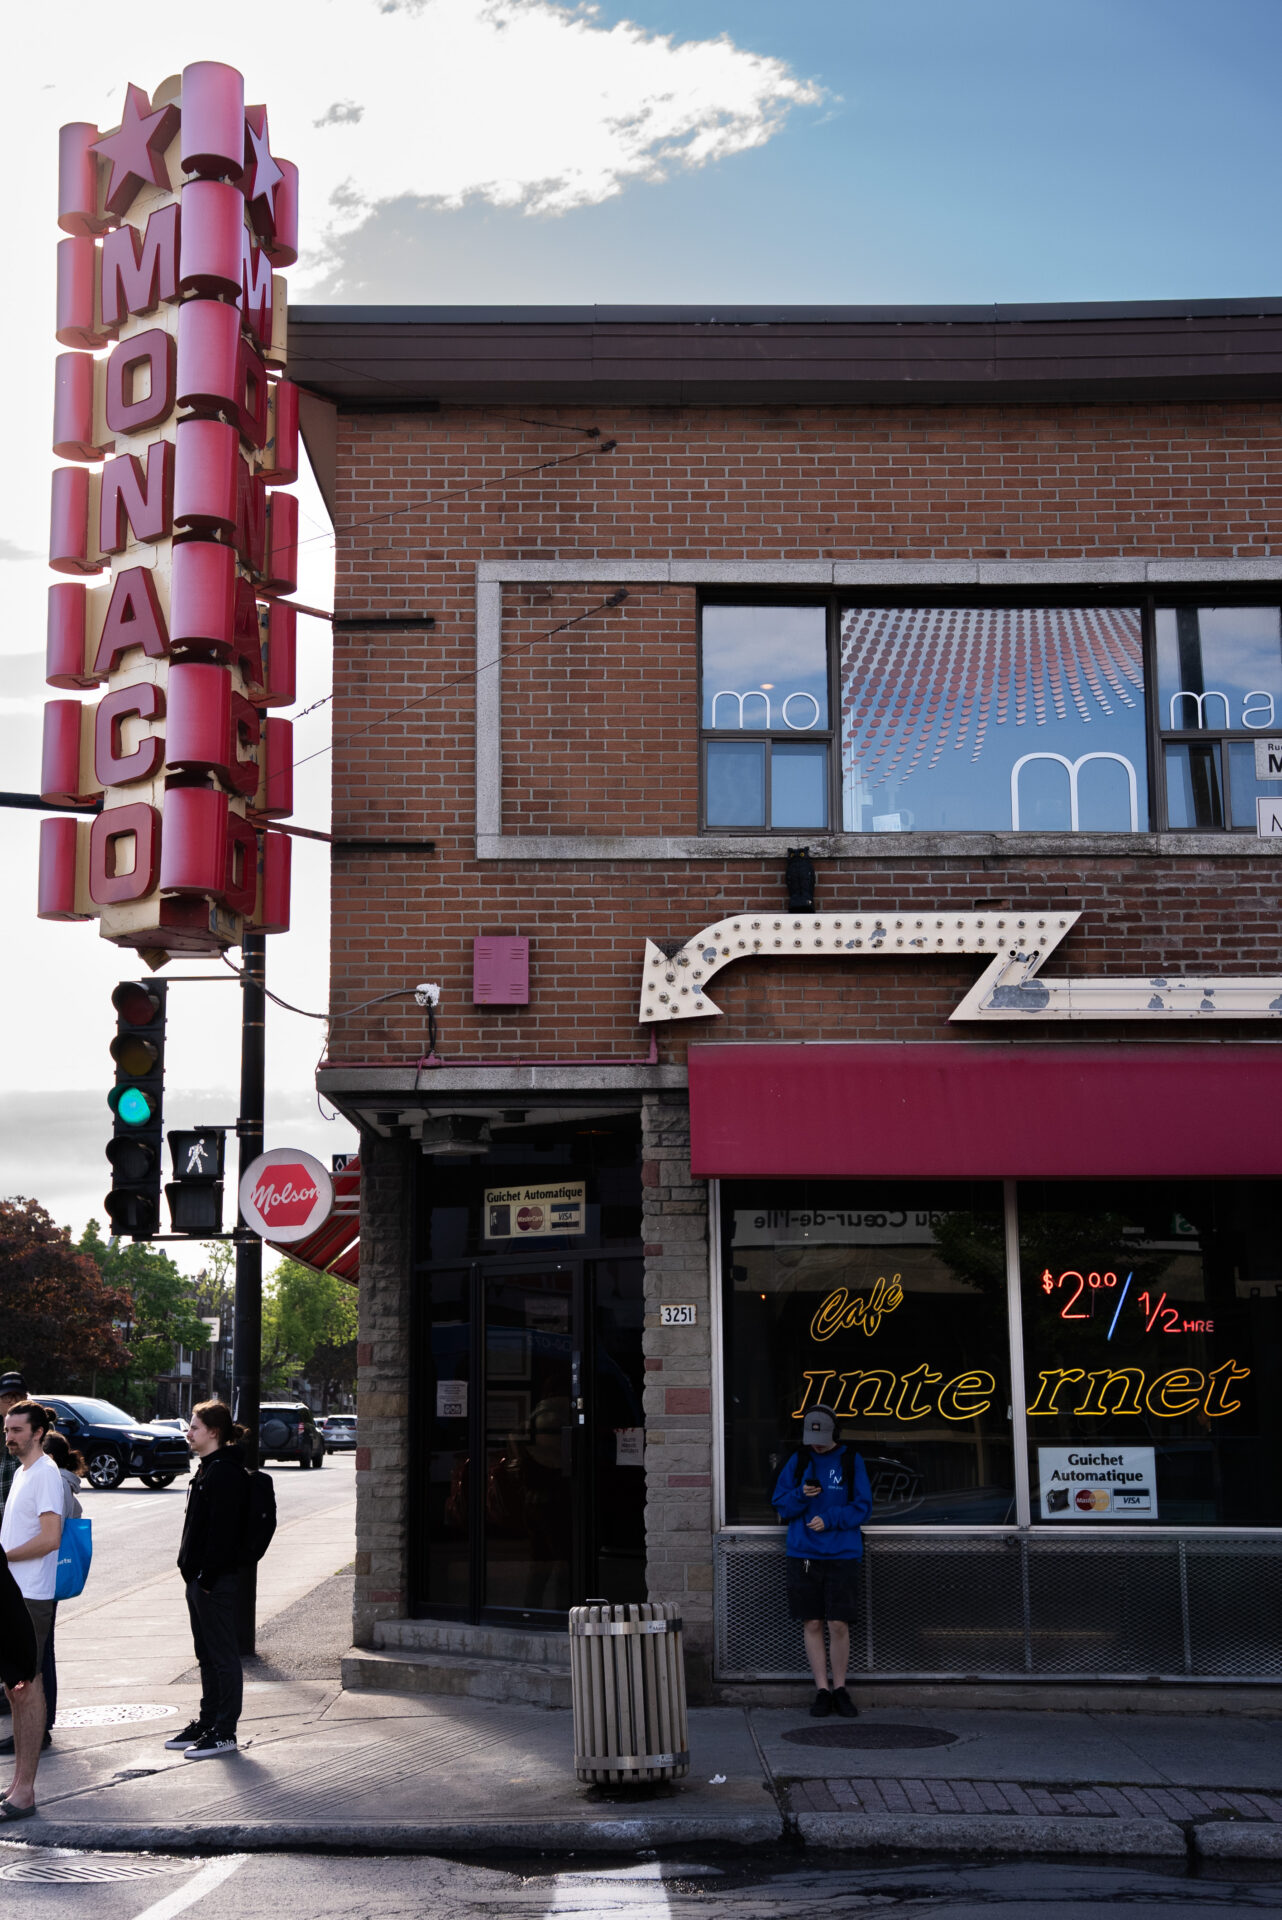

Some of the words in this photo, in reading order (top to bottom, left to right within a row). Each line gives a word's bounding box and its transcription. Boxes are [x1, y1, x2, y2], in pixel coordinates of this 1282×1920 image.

[90, 203, 181, 906] MONACO
[1268, 743, 1282, 751] Ru
[251, 1182, 320, 1215] Molson
[487, 1191, 521, 1203] Guichet
[524, 1187, 583, 1200] Automatique
[665, 1307, 692, 1322] 3251
[811, 1274, 904, 1342] Café
[1068, 1453, 1124, 1466] Guichet
[1051, 1469, 1143, 1484] Automatique
[216, 1740, 234, 1748] Polo
